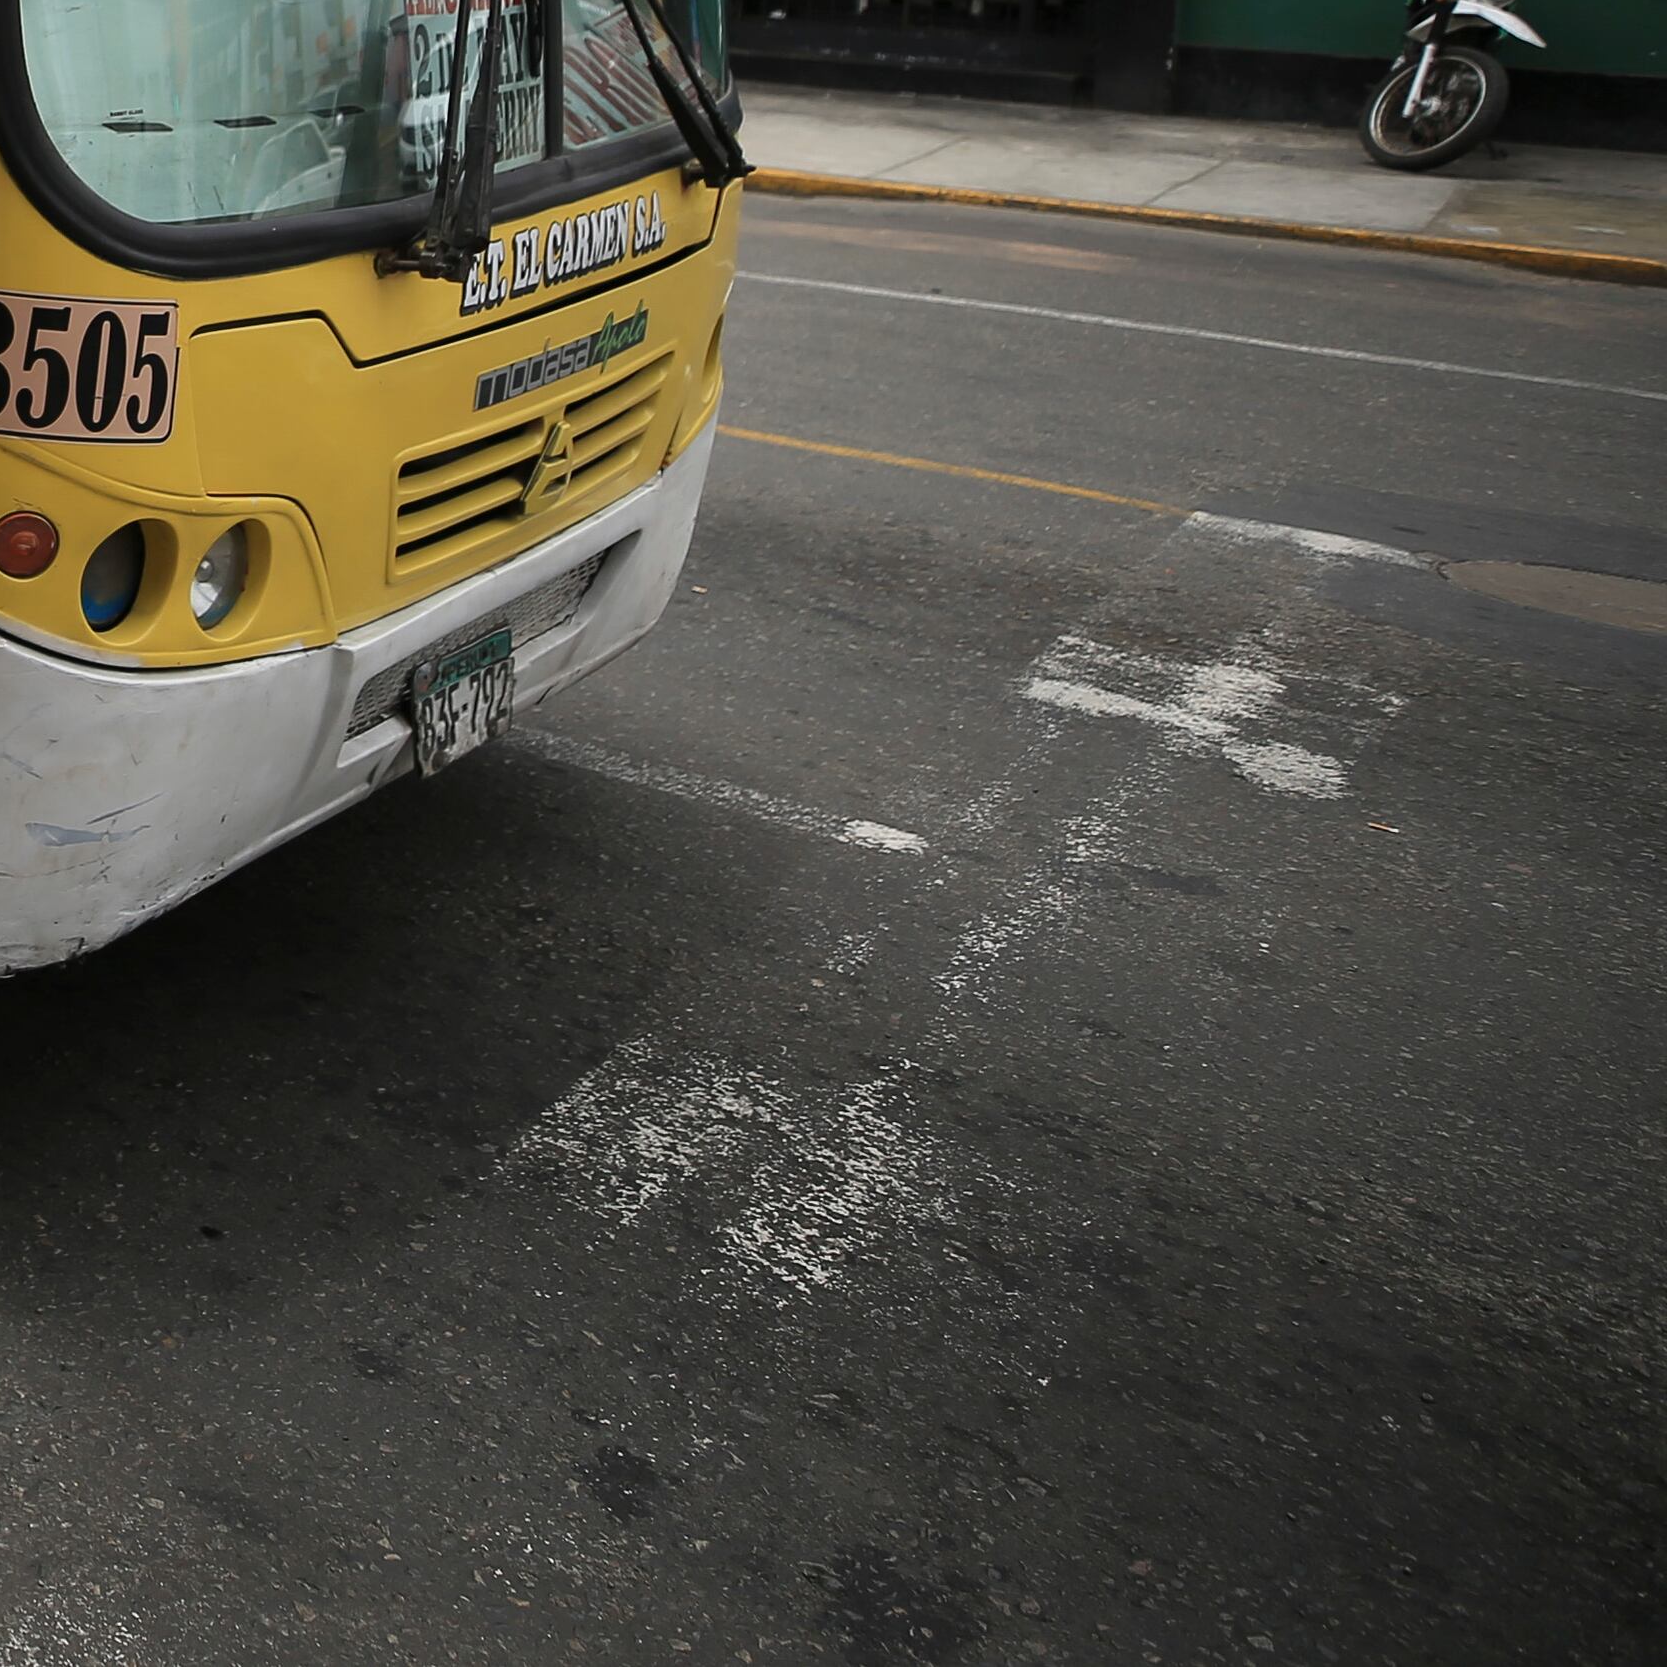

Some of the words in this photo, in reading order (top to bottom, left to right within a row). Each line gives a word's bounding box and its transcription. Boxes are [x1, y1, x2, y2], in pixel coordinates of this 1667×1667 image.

[463, 240, 507, 310] E.T.
[512, 226, 543, 293] EL
[545, 200, 630, 284] CARMEN
[633, 191, 666, 255] S.A.
[474, 336, 592, 411] modasa
